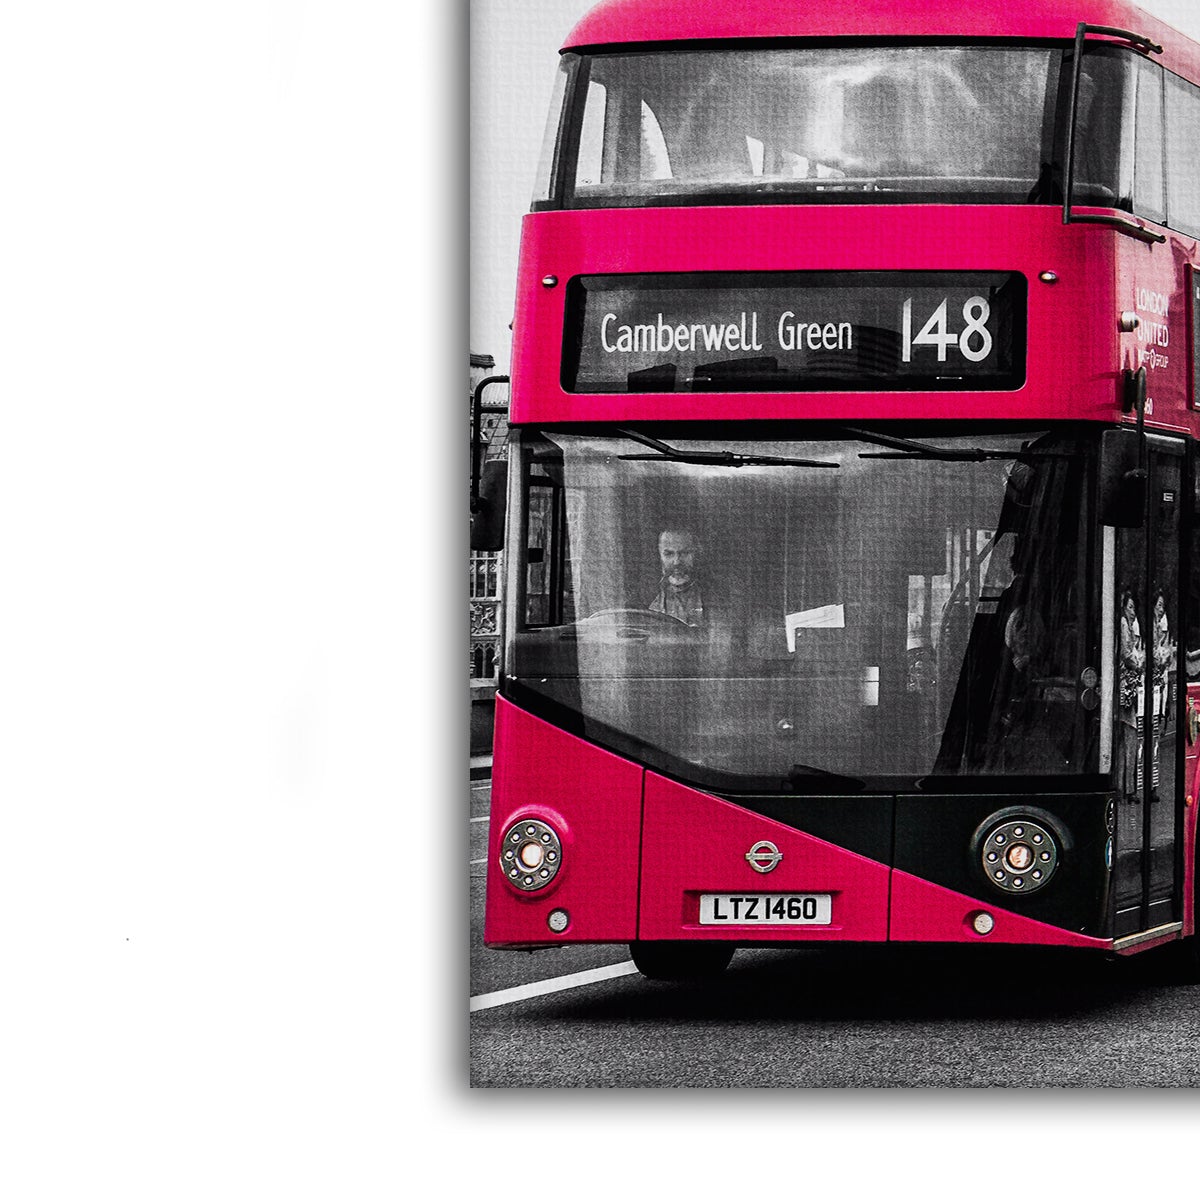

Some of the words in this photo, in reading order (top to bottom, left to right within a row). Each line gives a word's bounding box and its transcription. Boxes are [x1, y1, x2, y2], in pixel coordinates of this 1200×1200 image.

[600, 312, 762, 353] Camberwell
[777, 311, 852, 351] Green
[901, 295, 993, 363] 148
[714, 897, 759, 920] LTZ
[764, 897, 817, 920] 1460
